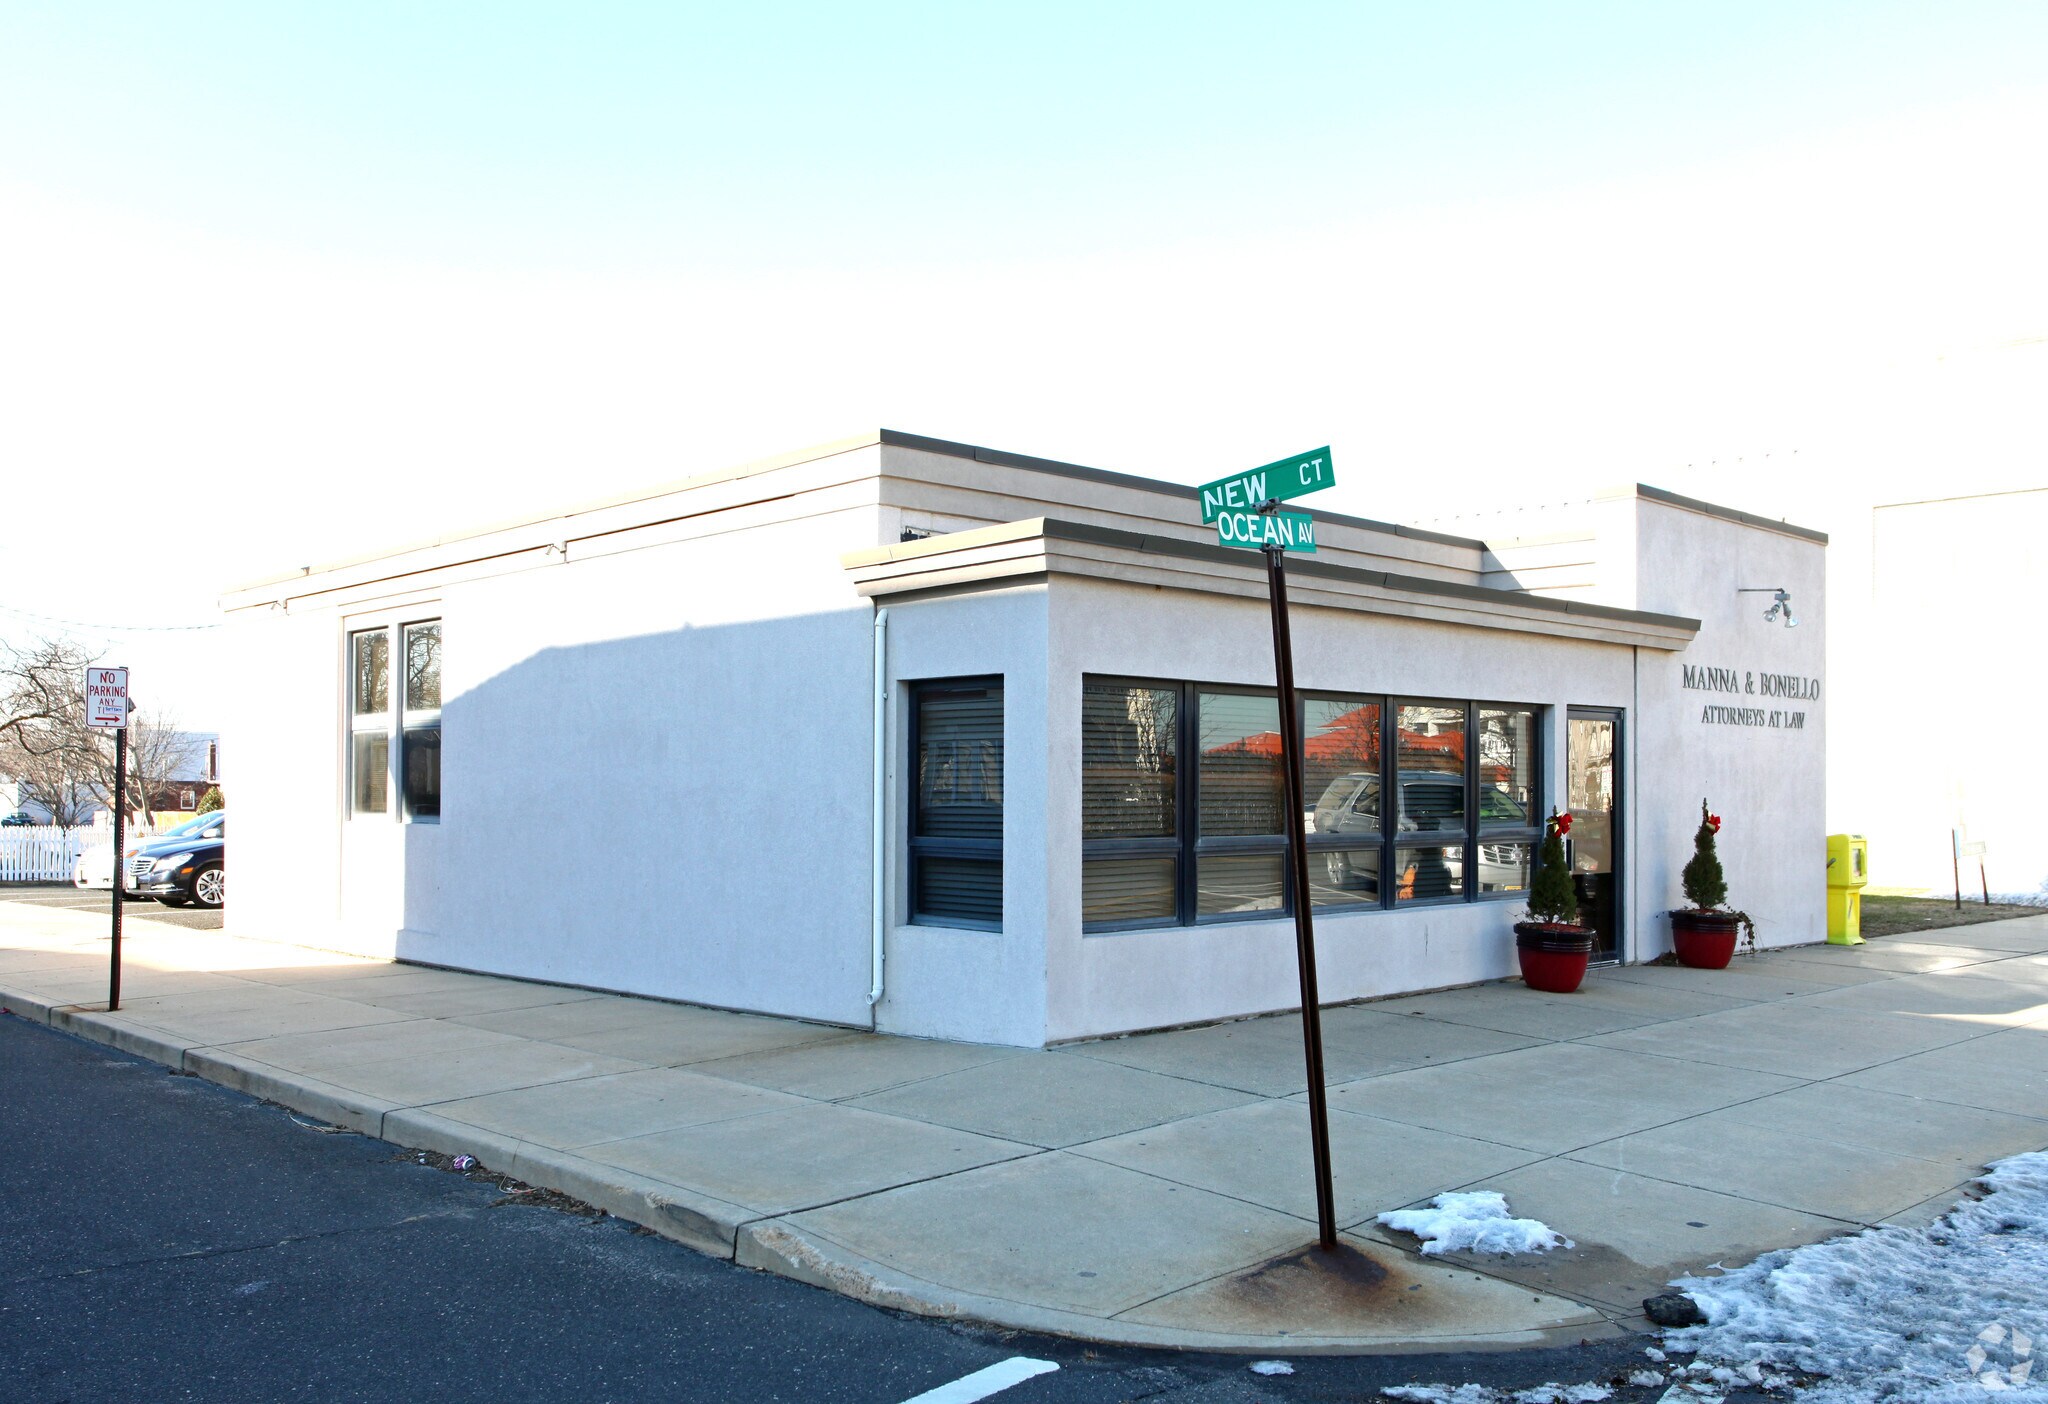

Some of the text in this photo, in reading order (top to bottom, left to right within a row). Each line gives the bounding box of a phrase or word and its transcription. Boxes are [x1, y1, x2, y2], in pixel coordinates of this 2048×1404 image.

[1203, 457, 1323, 518] NEW CT
[1217, 511, 1313, 546] OCEAN AV
[100, 673, 115, 684] NO
[1682, 664, 1820, 702] MANNA & BONELLO
[89, 685, 125, 698] PARKING
[99, 698, 115, 706] ANY
[1701, 705, 1806, 729] ATTORNEYS AT LAW
